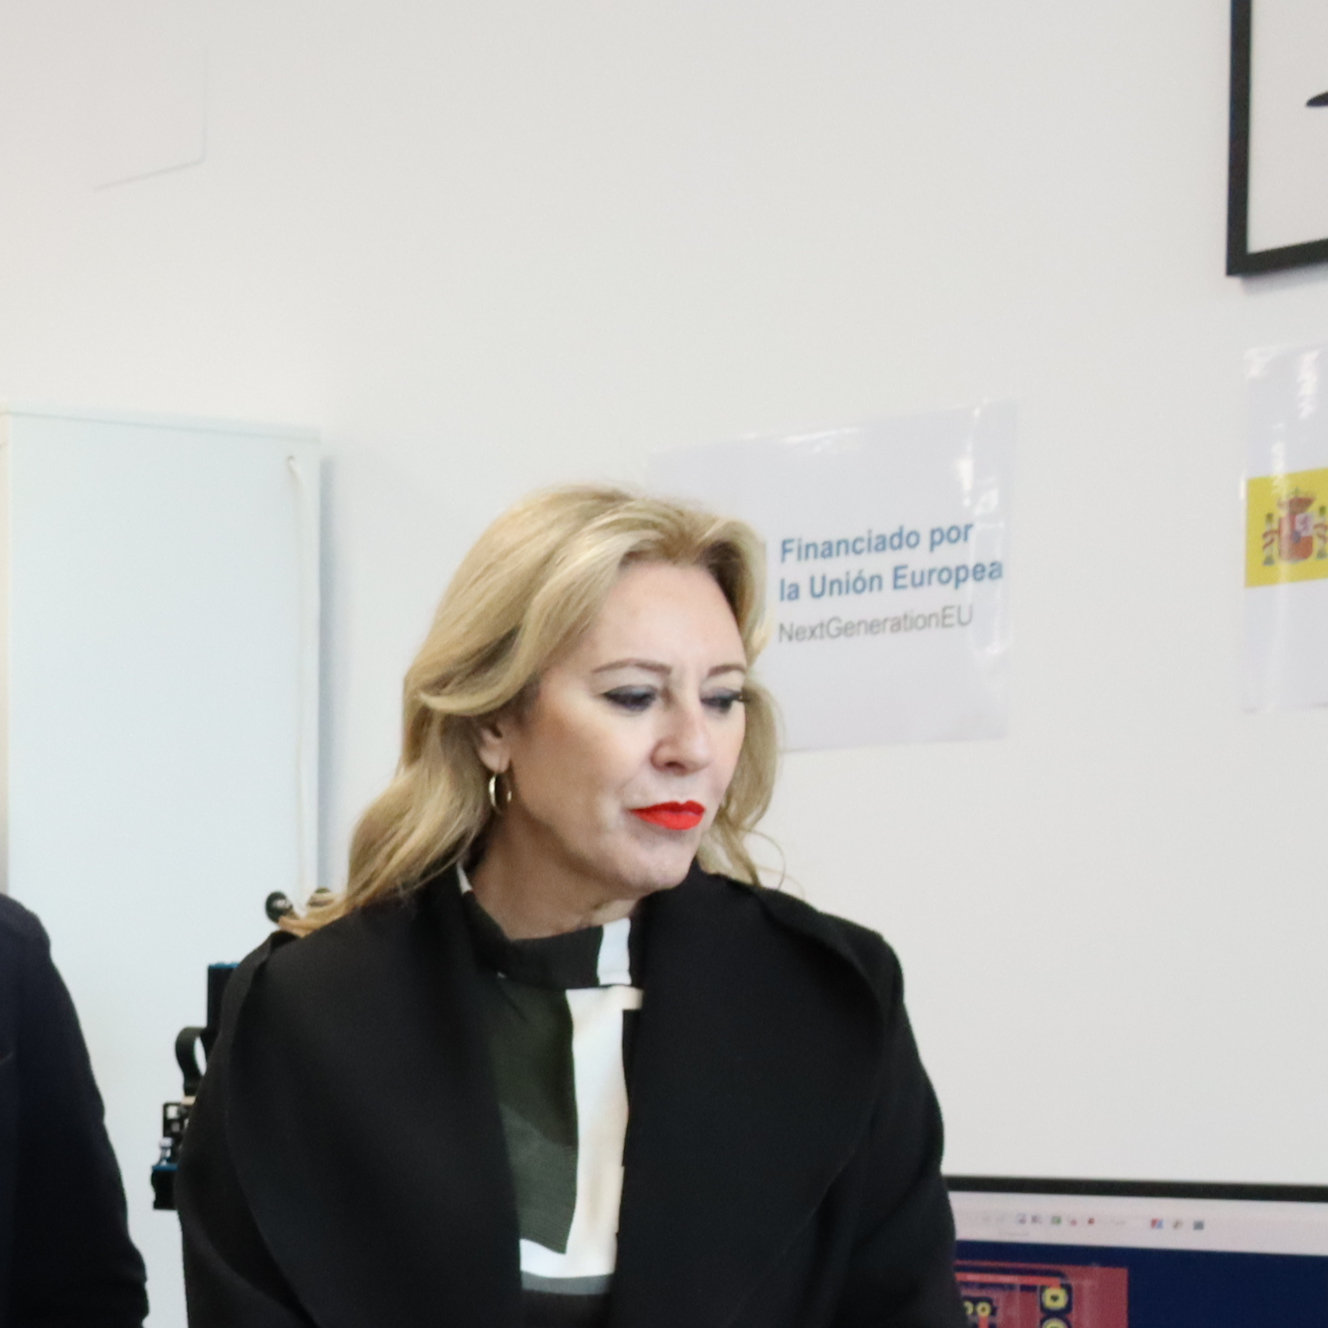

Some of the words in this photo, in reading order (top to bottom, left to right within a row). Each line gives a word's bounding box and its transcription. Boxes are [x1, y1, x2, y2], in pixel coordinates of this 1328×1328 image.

[780, 525, 921, 563] Financiado
[929, 523, 974, 552] por
[779, 578, 801, 602] la
[809, 569, 884, 599] Unión
[893, 560, 1004, 590] Europea
[778, 603, 974, 644] NextGenerationEU
